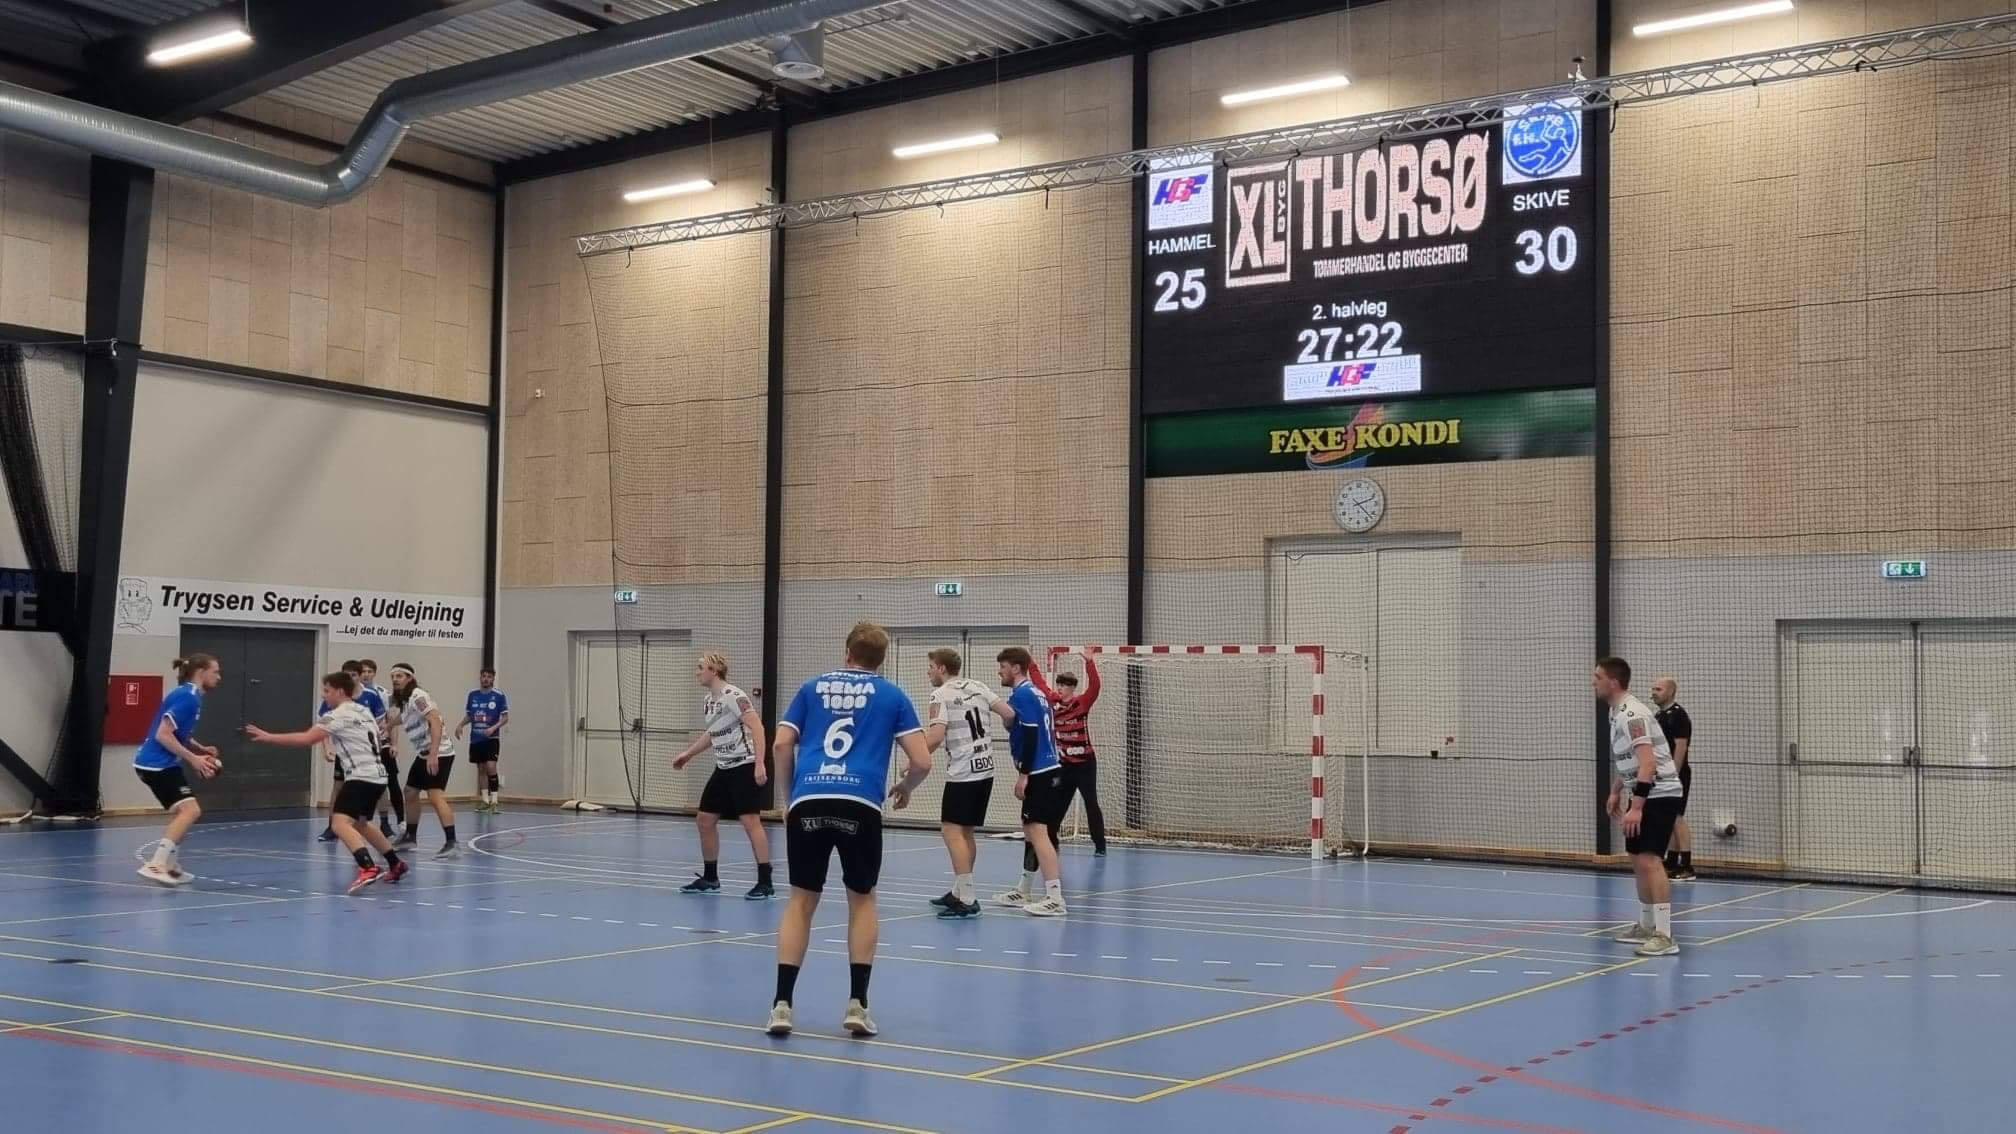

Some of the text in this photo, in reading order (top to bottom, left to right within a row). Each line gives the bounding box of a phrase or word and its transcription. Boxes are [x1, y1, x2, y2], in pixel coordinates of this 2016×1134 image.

[1277, 179, 1286, 233] BYG
[1296, 130, 1489, 250] THORSØ
[1513, 189, 1570, 211] SKIVE
[1149, 234, 1216, 255] HAMMEL
[1230, 180, 1285, 271] XL
[1313, 244, 1468, 278] TØMMERHANDEL OG BYGGECENTER
[1515, 226, 1577, 274] 30
[1154, 268, 1206, 312] 25
[1312, 300, 1387, 320] 2. halvleg
[1297, 321, 1403, 363] 27:22
[1269, 420, 1461, 453] FAXE KONDI
[161, 585, 464, 627] Trygsen Service & Udlejning
[360, 625, 375, 635] det
[376, 626, 388, 636] du
[390, 627, 426, 639] mangler
[427, 628, 436, 637] til
[438, 628, 464, 639] festen
[815, 681, 875, 695] REMA
[822, 694, 867, 710] 1000
[823, 717, 854, 759] 6
